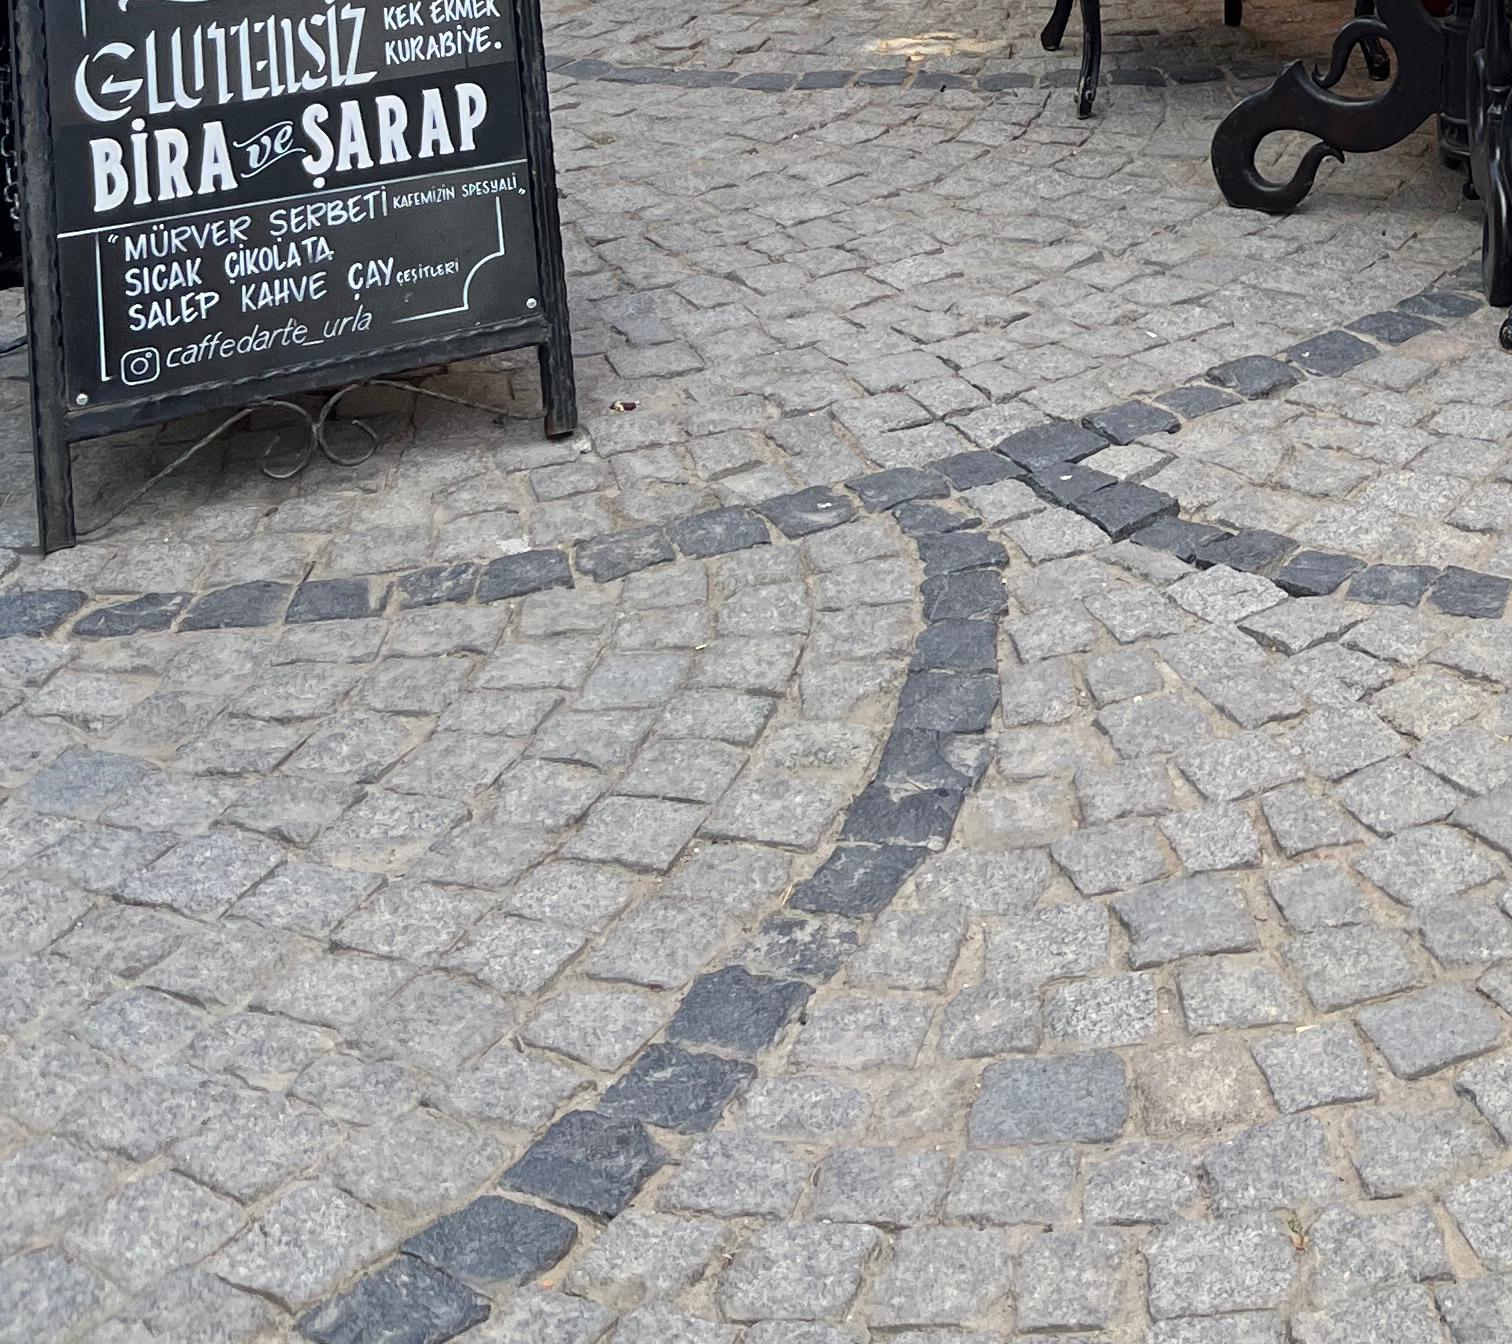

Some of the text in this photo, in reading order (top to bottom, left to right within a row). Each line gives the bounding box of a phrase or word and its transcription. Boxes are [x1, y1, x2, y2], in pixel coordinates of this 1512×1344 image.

[383, 2, 424, 30] KEK
[90, 82, 487, 212] BİRA ve ŞARAP
[270, 186, 389, 245] ŞERBETİ
[393, 184, 456, 210] KAFEMİZİN
[125, 236, 334, 297] SICAK ÇİKOLATA
[128, 257, 460, 332] SALEP KAHVE ÇAY ÇEŞİTLERİ
[166, 304, 373, 369] caffedarte_urla
